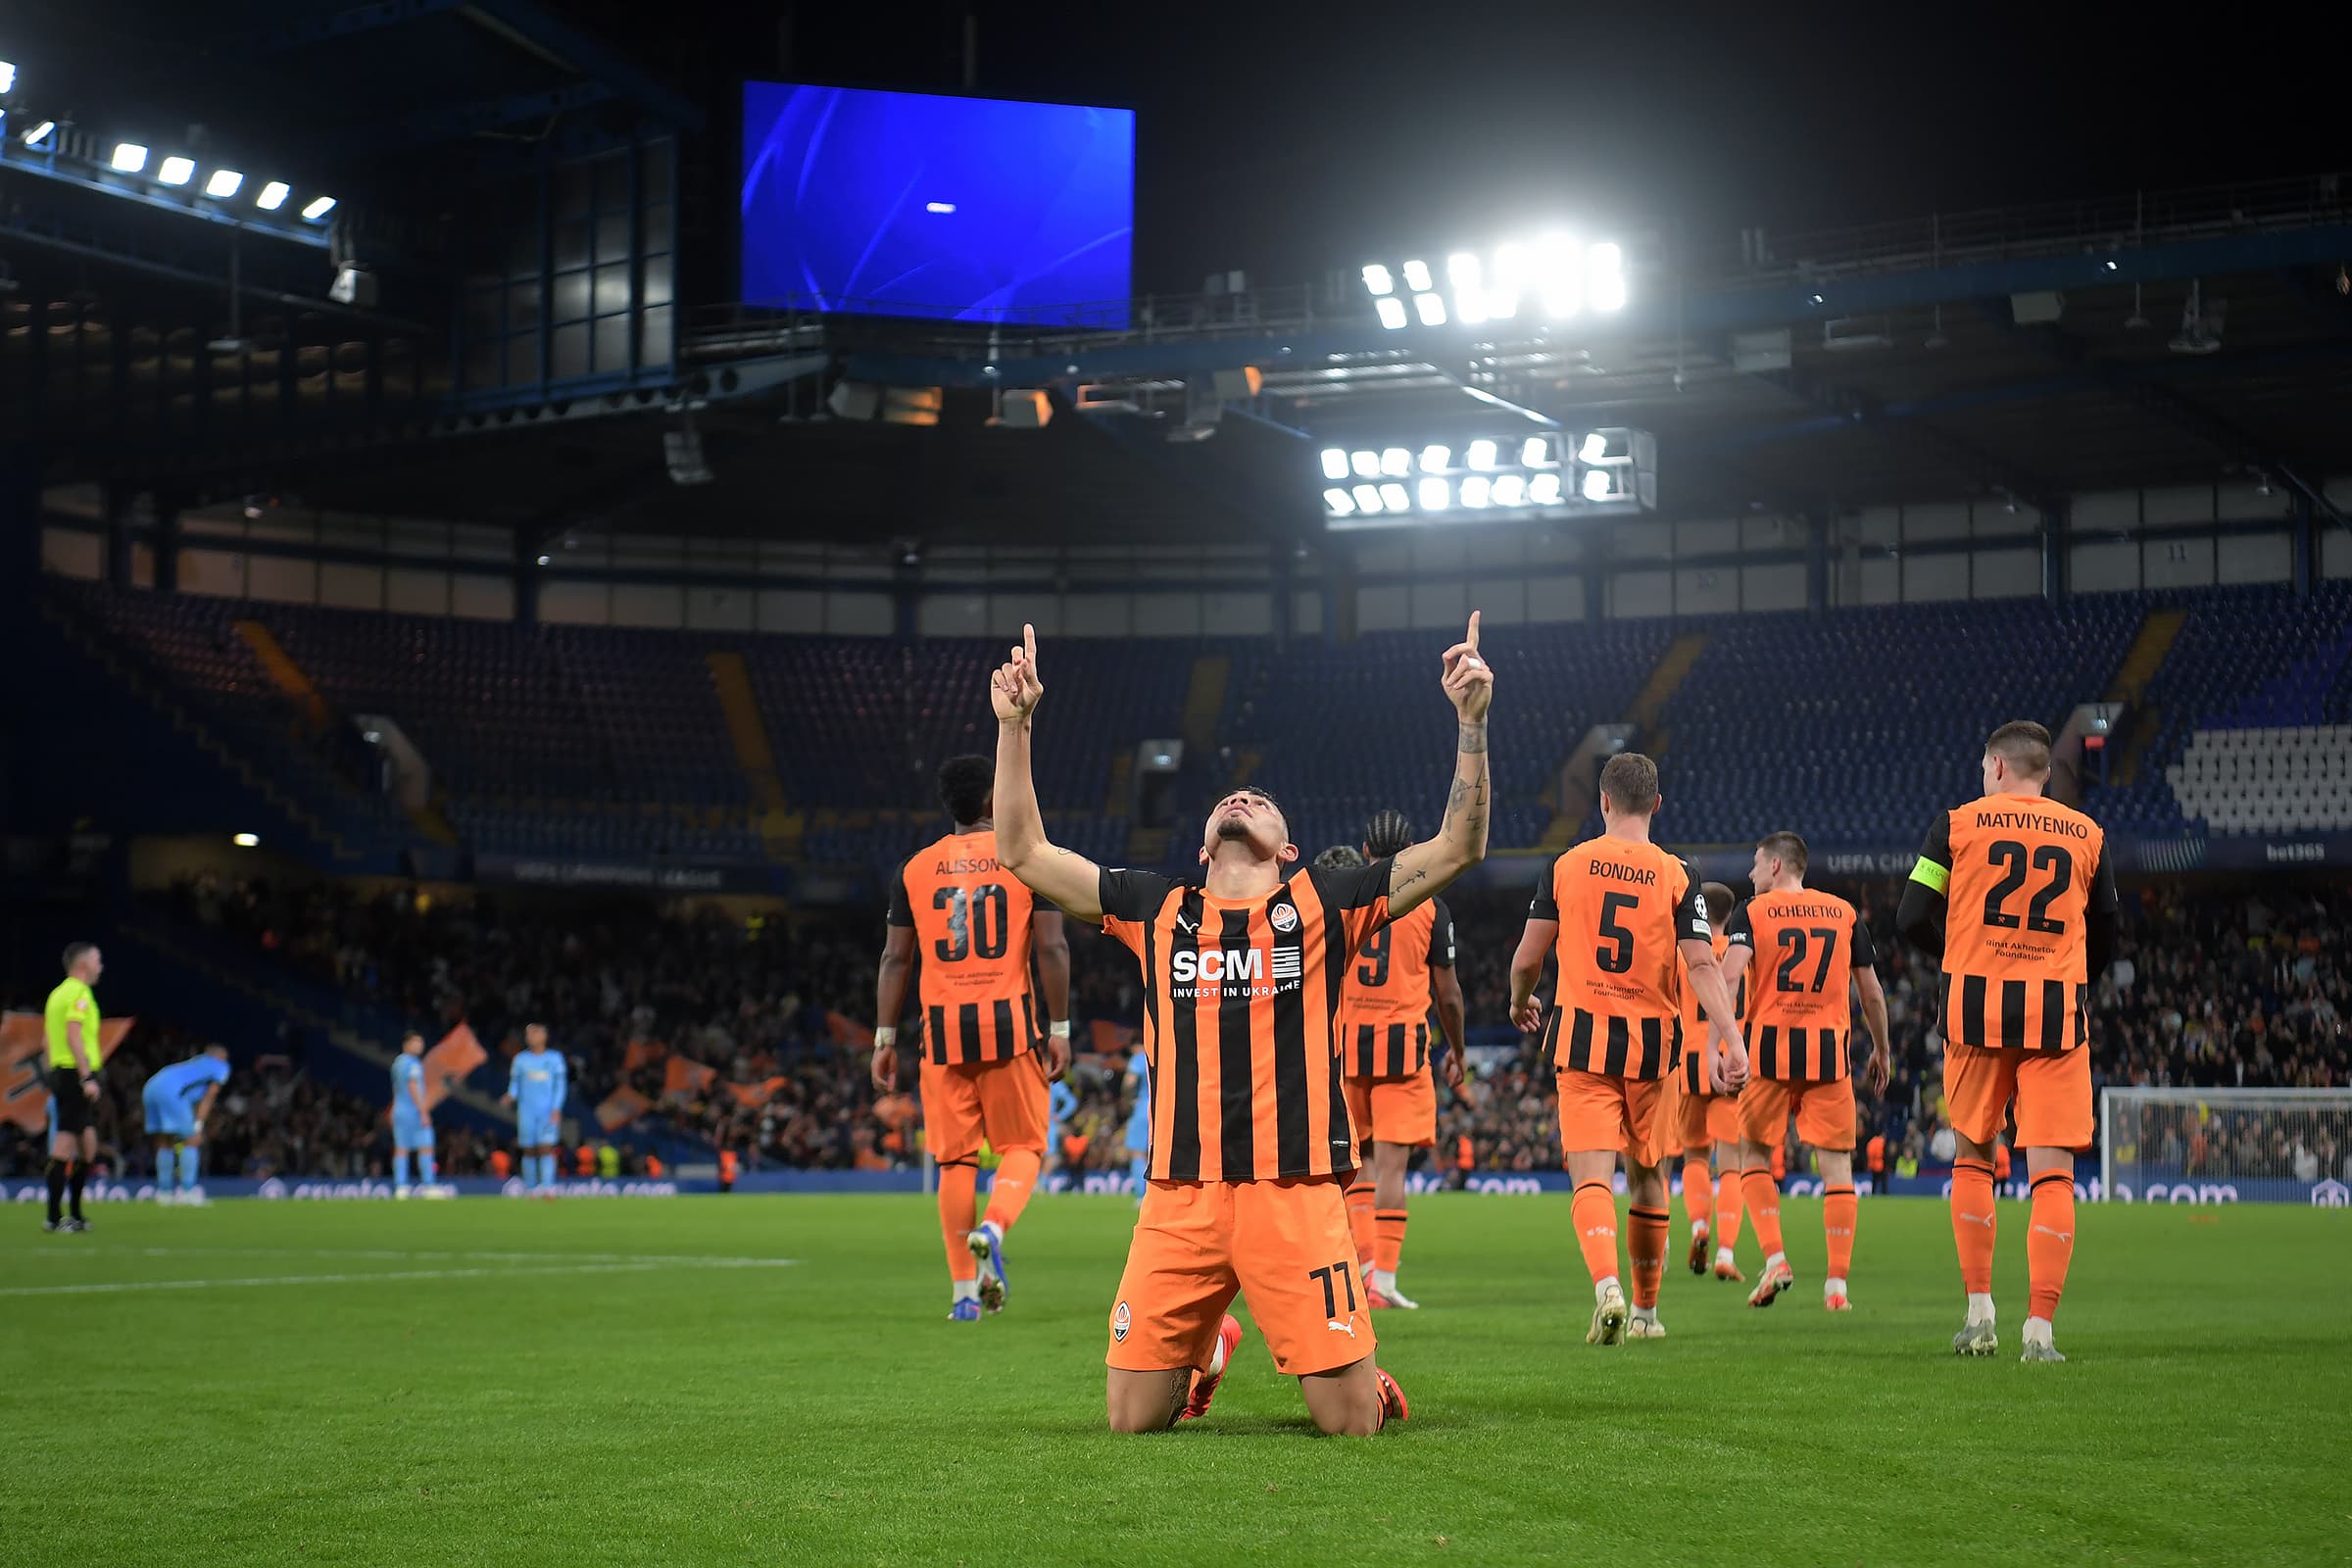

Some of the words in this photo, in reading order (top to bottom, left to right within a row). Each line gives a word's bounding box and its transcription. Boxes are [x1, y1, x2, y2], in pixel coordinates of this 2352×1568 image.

[1976, 812, 2088, 840] MATVIYENKO
[935, 858, 1001, 875] ALISSON
[1589, 859, 1656, 886] BONDAR
[1827, 854, 1875, 871] UEFA
[1879, 853, 1919, 871] CHA
[1984, 840, 2072, 935] 22
[933, 884, 1008, 961] 30
[1767, 904, 1842, 918] OCHERETKO
[1596, 891, 1640, 973] 5
[1357, 921, 1392, 987] 9
[1777, 927, 1838, 993] 27
[1985, 939, 2008, 950] Rinat
[2010, 942, 2056, 955] Akhmetov
[1994, 949, 2045, 961] Foundation
[1173, 949, 1263, 982] SCM
[1173, 988, 1219, 998] INVEST
[1223, 987, 1238, 997] IN
[1242, 980, 1300, 997] UKRAINE
[1309, 1261, 1356, 1319] 11
